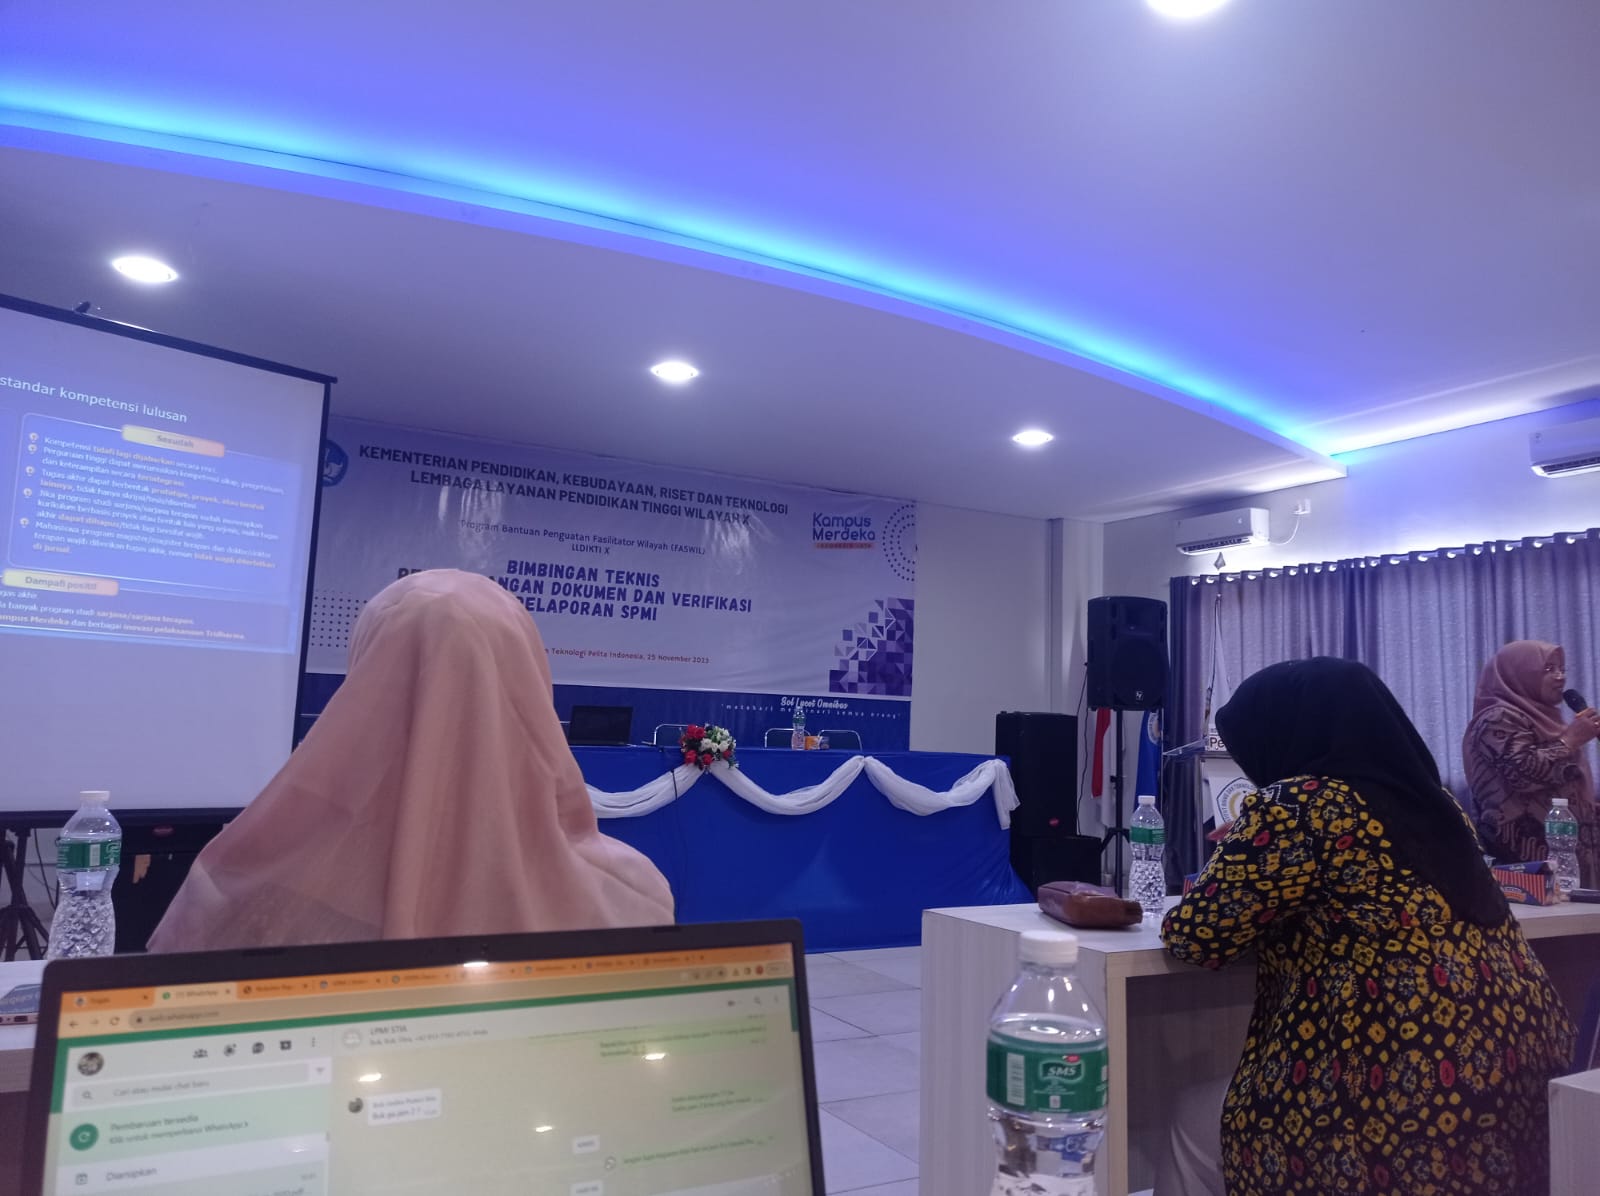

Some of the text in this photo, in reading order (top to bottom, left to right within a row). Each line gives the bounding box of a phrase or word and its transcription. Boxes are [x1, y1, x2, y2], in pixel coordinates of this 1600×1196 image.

[0, 377, 187, 423] standar kompetensi lulusan
[359, 445, 789, 515] KEMENTERIAN PENDIDIKAN, KEBUDAYAAN, RISET DAN TEKNOLOGI
[411, 470, 750, 525] LEMBAGA LAYANAN PENDIDIKAN TINGGI WILAYAH X
[813, 512, 872, 529] Kampus
[460, 519, 706, 555] Program Bantuan Penguatan Fasilitator Wilayah (FASWIL)
[813, 527, 876, 541] Merdeka
[603, 546, 611, 555] X
[507, 559, 660, 588] BIMBINGAN TEKNIS
[551, 579, 626, 601] DOKUMEN
[633, 591, 665, 606] DAN
[672, 592, 752, 613] VERIFIKASI
[621, 605, 658, 622] SPMI
[551, 647, 586, 659] Teknologi
[1047, 1066, 1077, 1077] SMS
